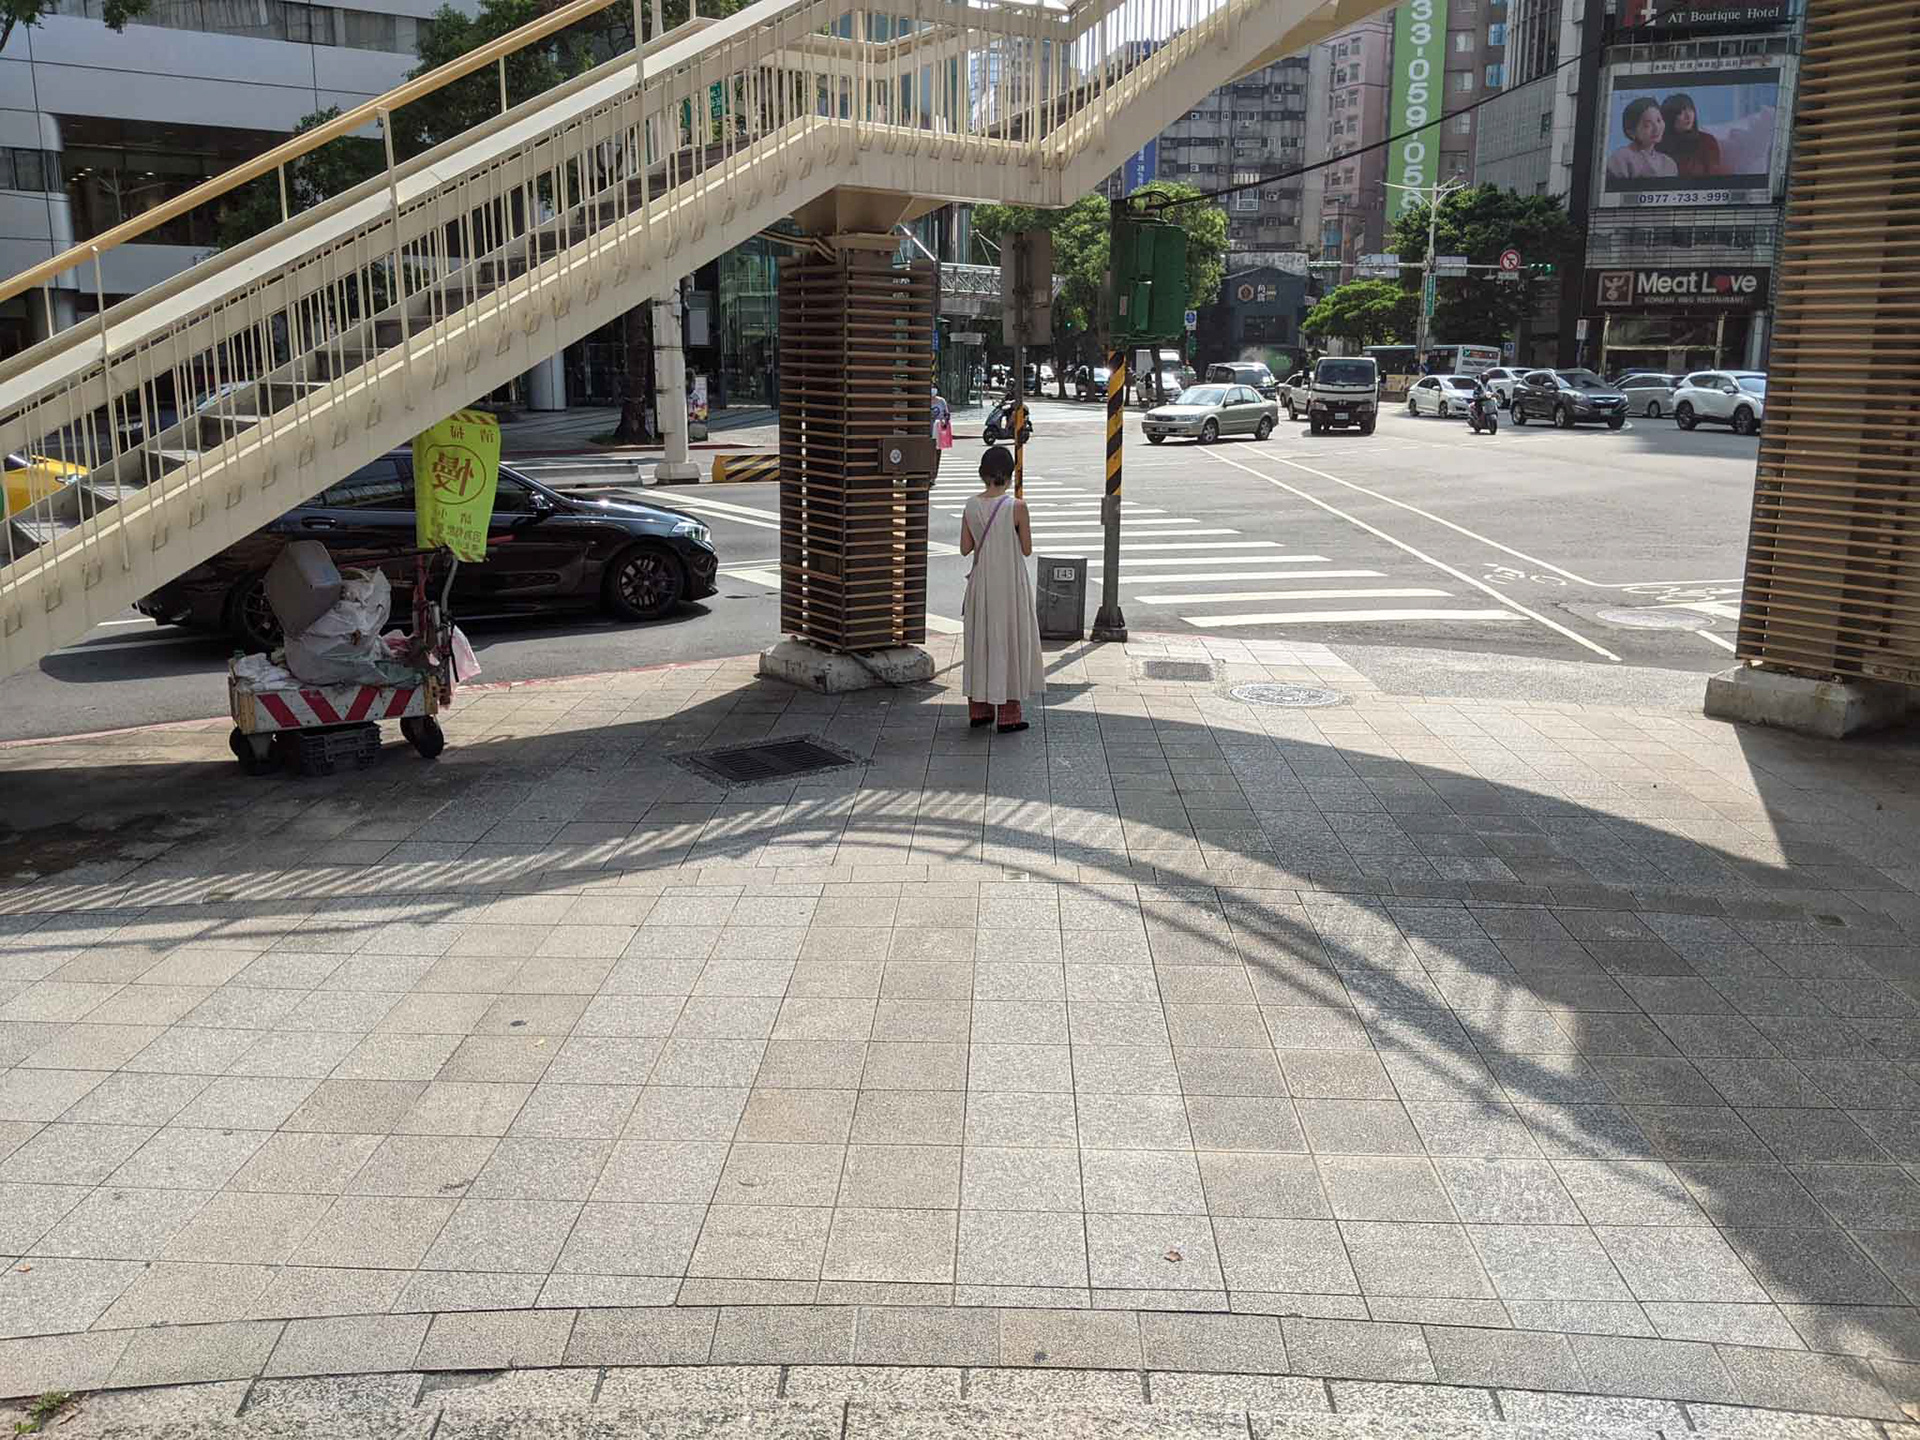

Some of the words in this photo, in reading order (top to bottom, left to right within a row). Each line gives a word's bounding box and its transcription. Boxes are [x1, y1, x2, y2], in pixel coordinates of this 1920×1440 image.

[1668, 12, 1685, 24] AT
[1690, 11, 1741, 24] Boutique
[1747, 7, 1779, 19] Hotel
[1637, 271, 1698, 294] Meat
[1057, 569, 1073, 579] 143
